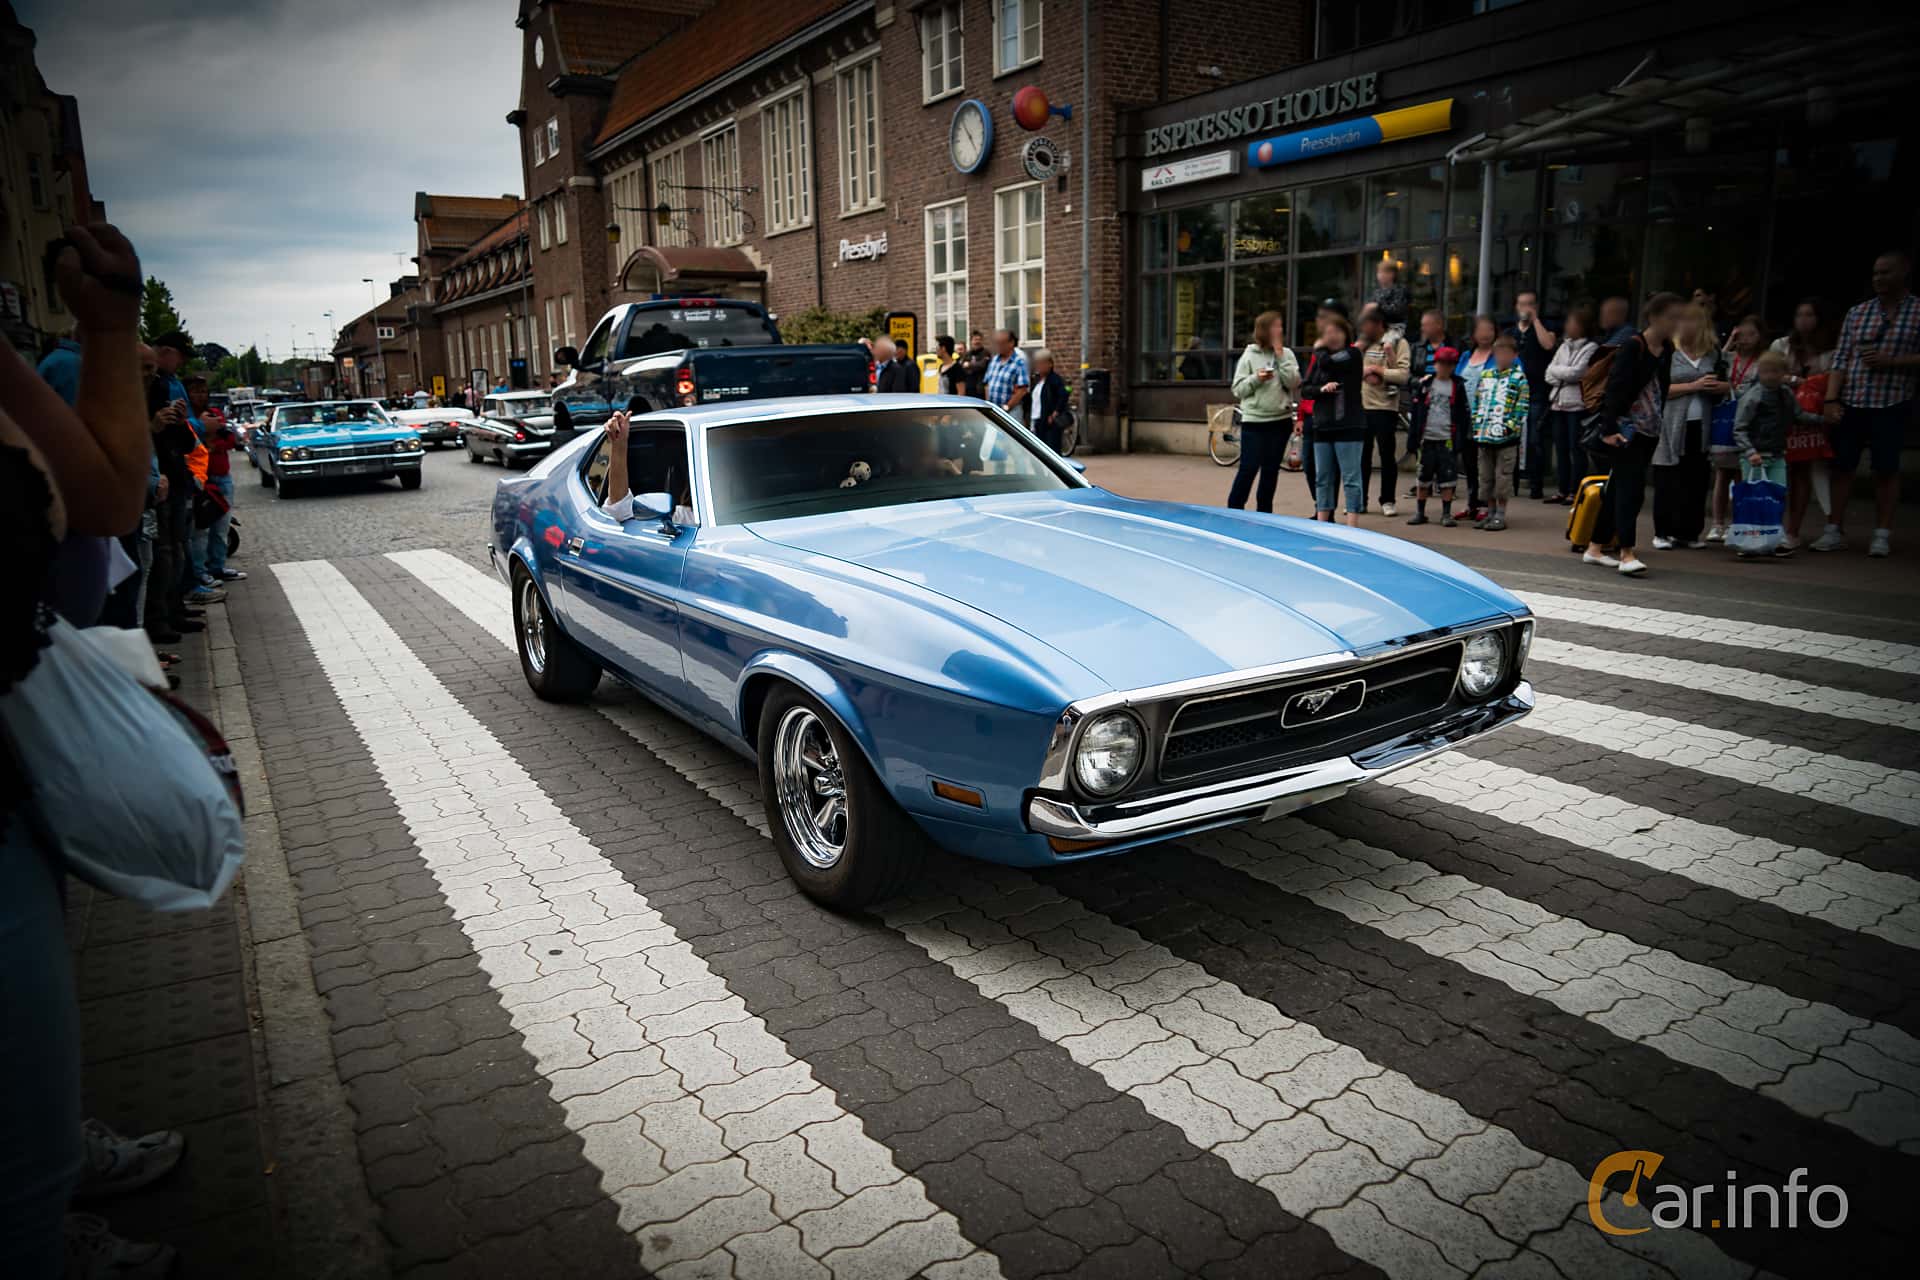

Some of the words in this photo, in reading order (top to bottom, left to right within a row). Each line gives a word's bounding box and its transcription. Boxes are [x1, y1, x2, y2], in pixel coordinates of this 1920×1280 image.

[1145, 102, 1265, 157] ESPRESSO
[1262, 72, 1377, 131] HOUSE
[1301, 128, 1361, 153] Pressbyrån
